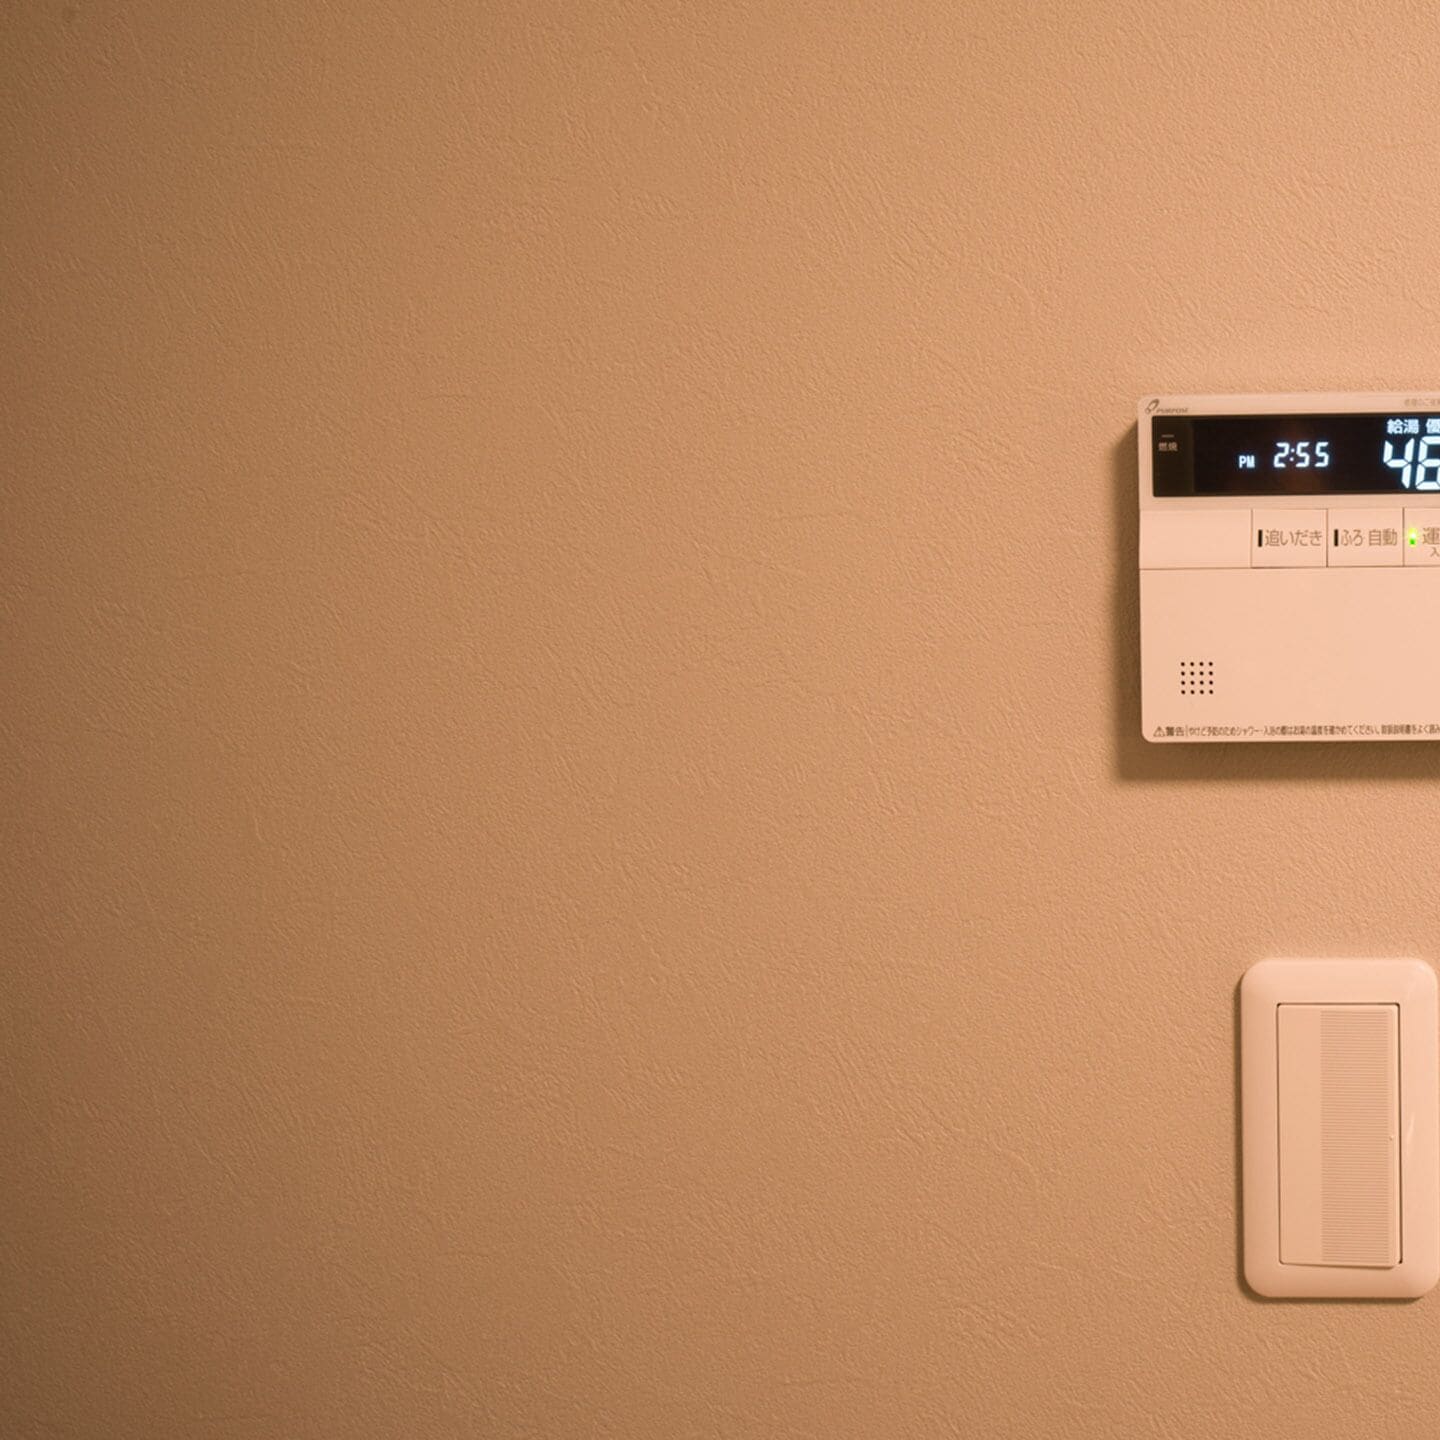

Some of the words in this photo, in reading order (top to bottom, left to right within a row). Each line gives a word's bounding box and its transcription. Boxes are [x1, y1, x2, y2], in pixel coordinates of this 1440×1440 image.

[1386, 419, 1419, 434] 給湯
[1238, 455, 1256, 469] PM
[1273, 441, 1329, 468] 2:55
[1264, 529, 1323, 546] 追いだき
[1340, 530, 1364, 546] ふろ
[1368, 529, 1398, 546] 自動
